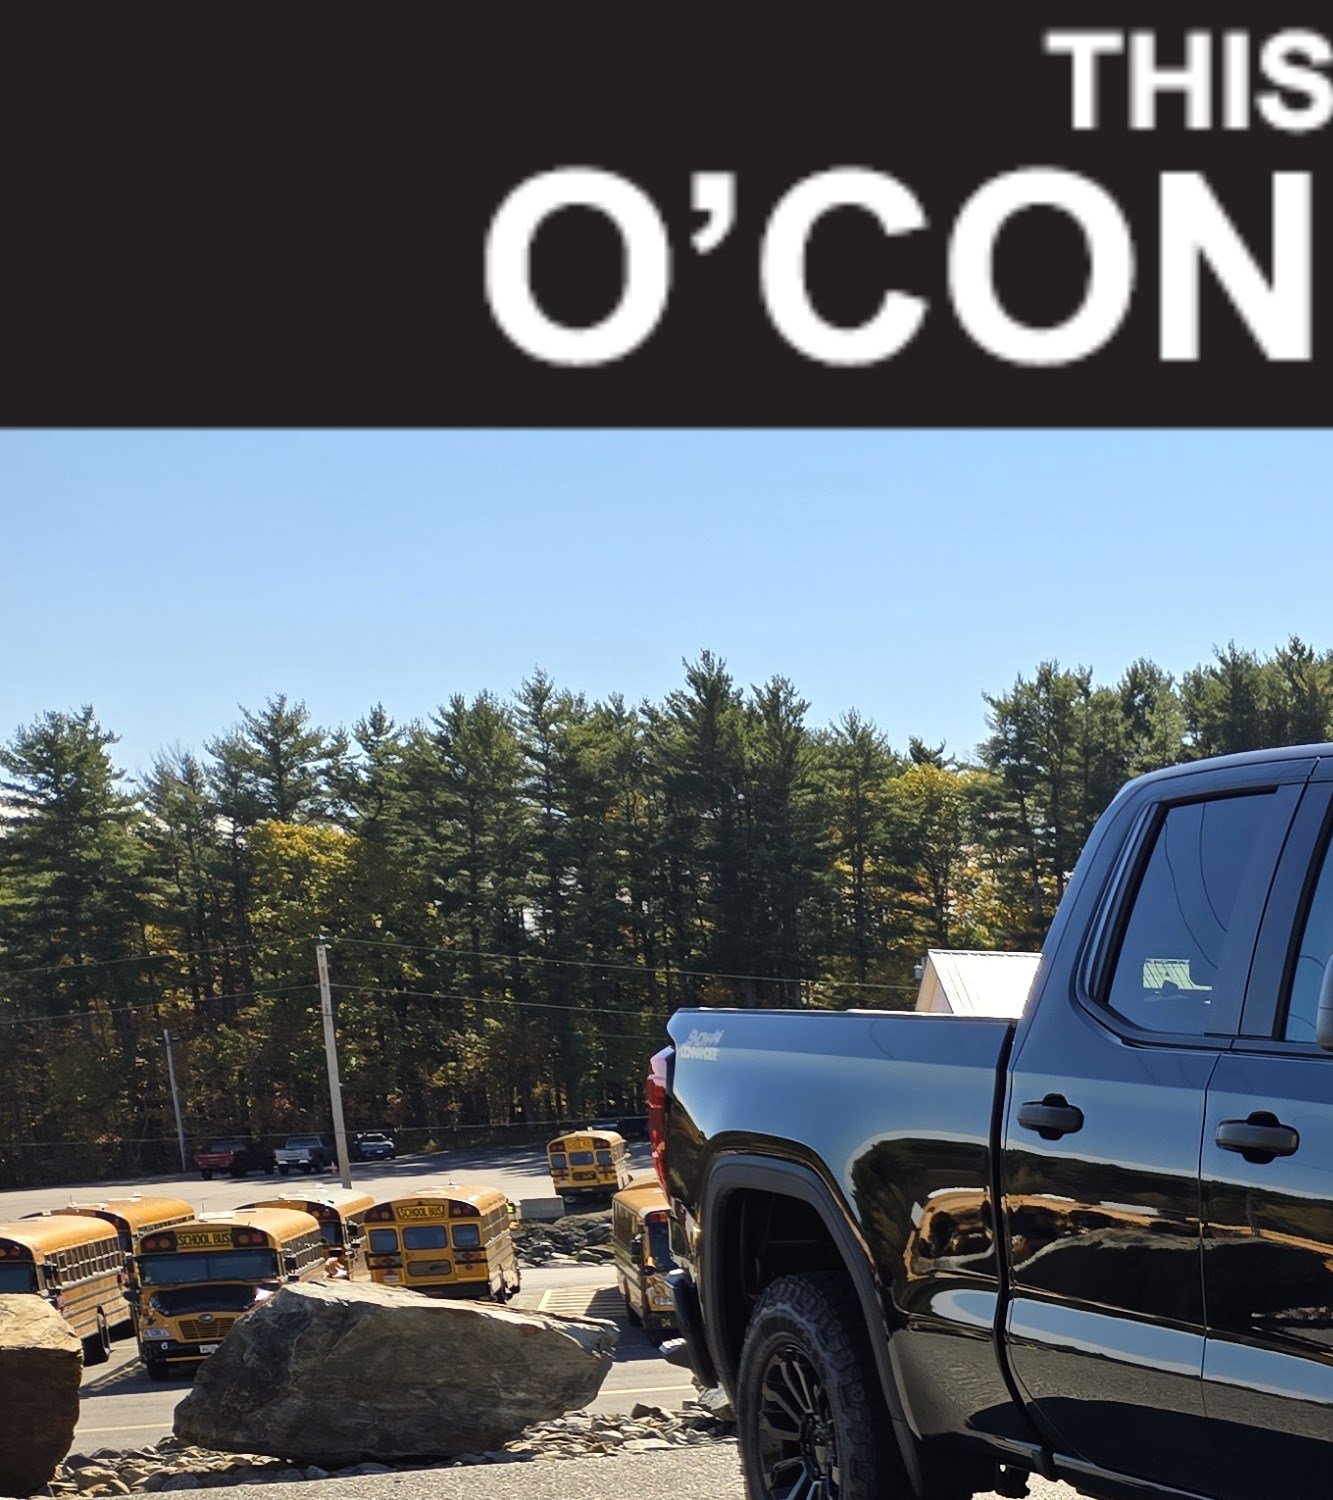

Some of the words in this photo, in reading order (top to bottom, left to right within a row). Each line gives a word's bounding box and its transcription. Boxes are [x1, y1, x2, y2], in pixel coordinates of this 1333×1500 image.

[400, 1207, 428, 1218] SCHOOL
[429, 1205, 443, 1216] BUS
[179, 1233, 212, 1246] SCHOOL
[213, 1232, 231, 1244] BUS
[161, 1341, 169, 1350] 6
